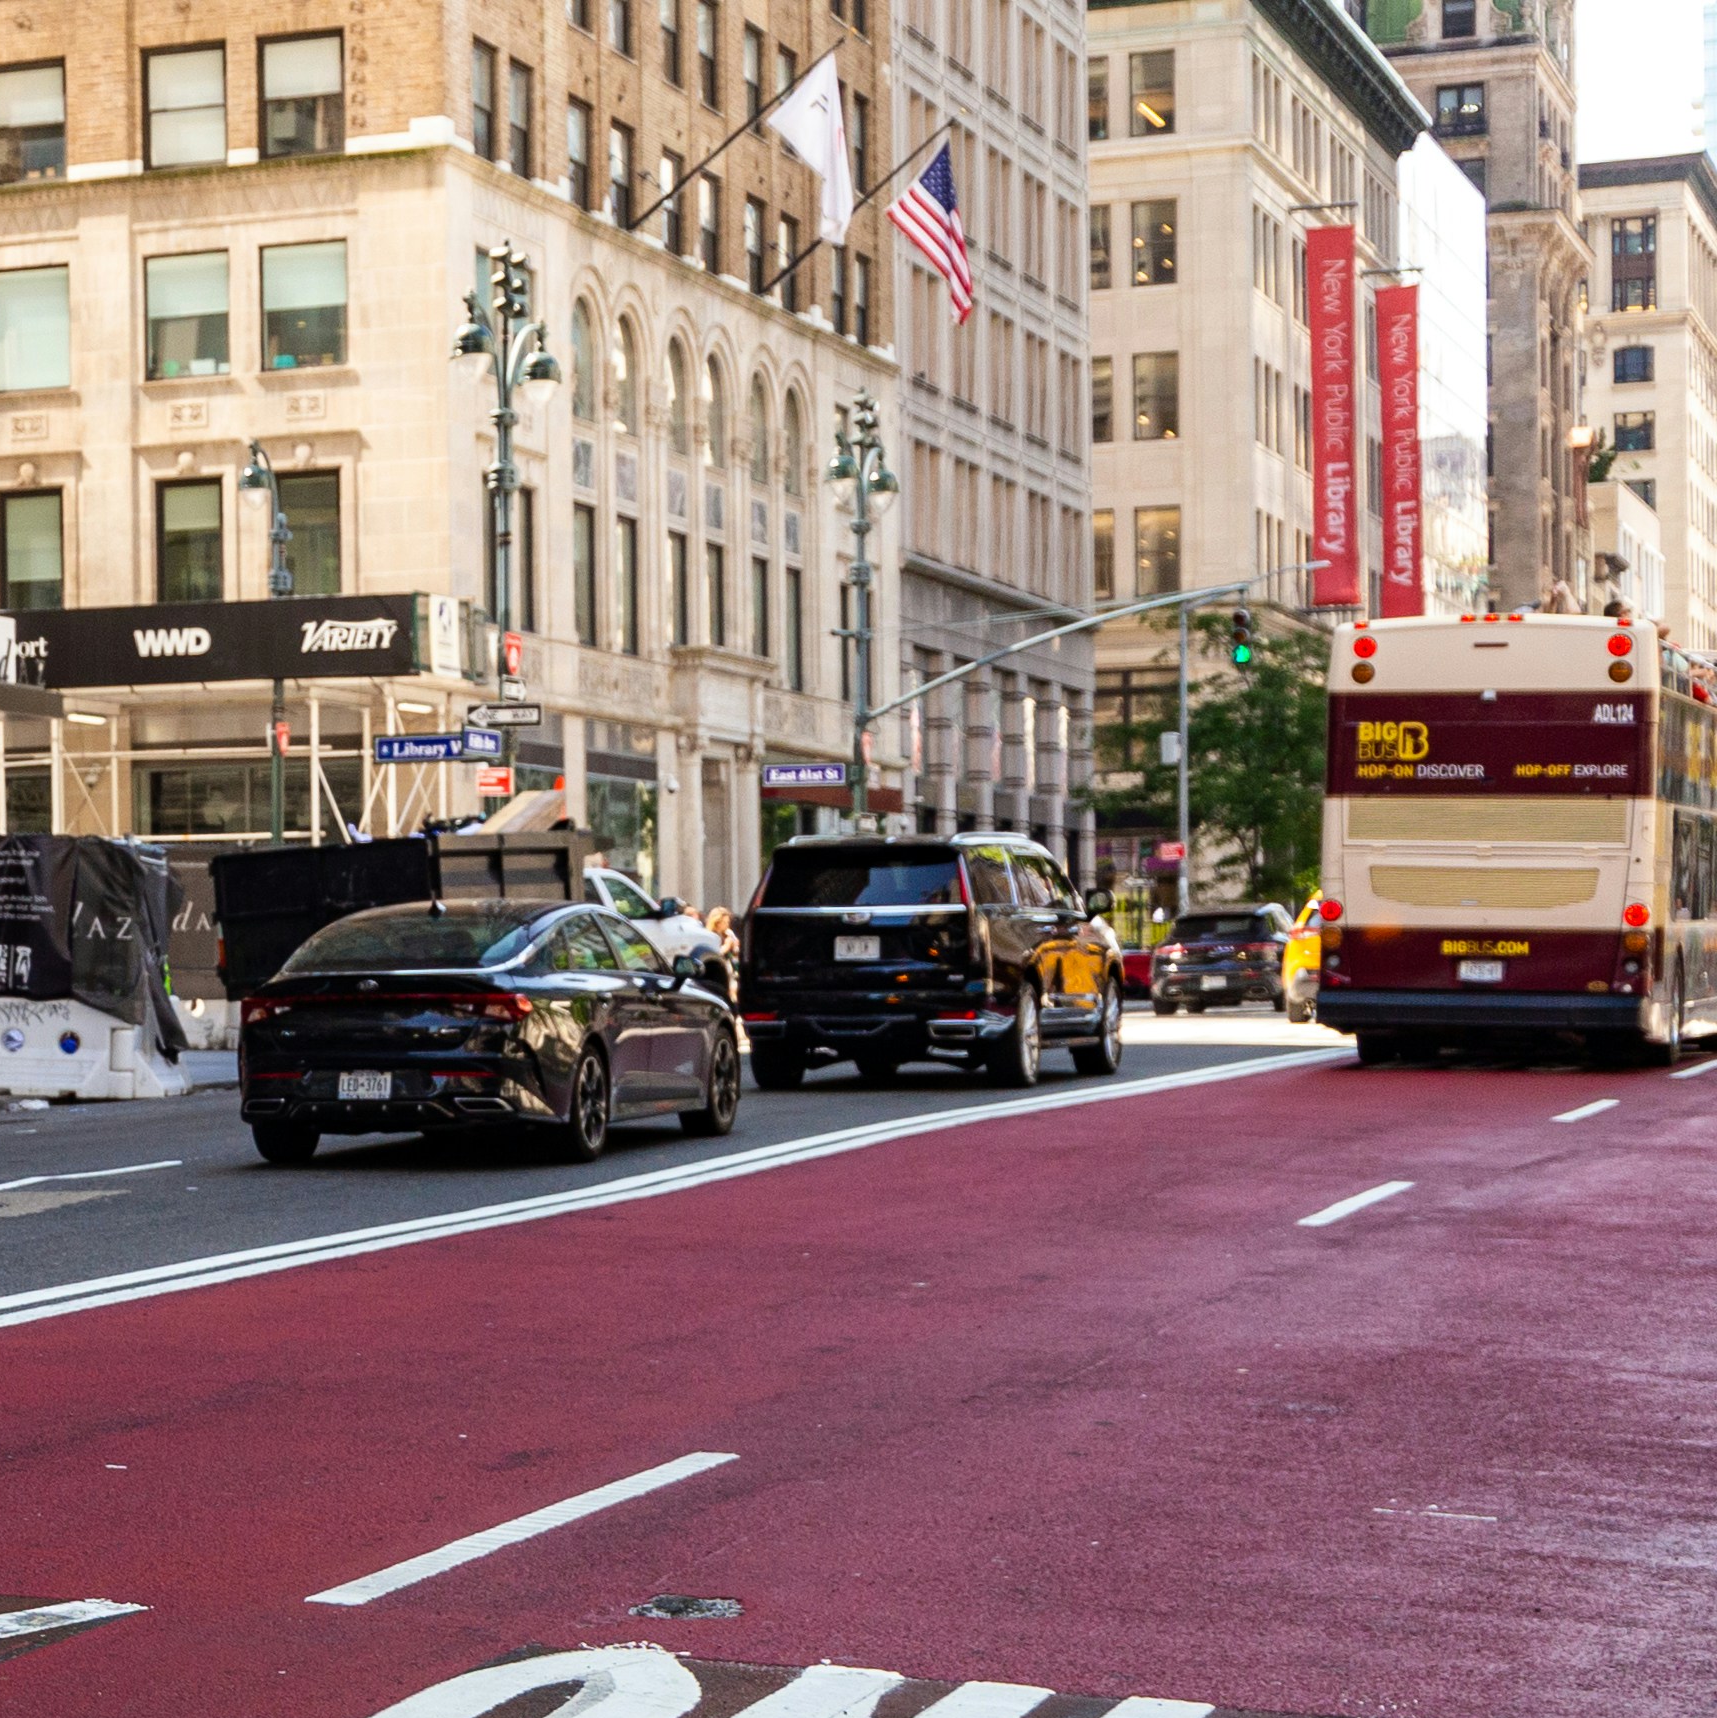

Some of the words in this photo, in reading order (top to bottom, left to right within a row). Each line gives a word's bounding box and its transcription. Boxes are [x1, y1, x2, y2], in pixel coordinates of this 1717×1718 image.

[1322, 259, 1346, 313] New
[1324, 322, 1347, 373] York
[1391, 314, 1412, 365] New
[1392, 376, 1415, 420] York
[1325, 384, 1349, 450] Public
[1393, 429, 1416, 490] Public
[1321, 461, 1350, 553] Library
[1388, 501, 1417, 586] Library
[133, 626, 213, 657] WWD
[300, 617, 399, 654] VARIETY
[1593, 704, 1635, 723] ADL124
[392, 738, 446, 758] Library
[1357, 722, 1397, 741] BIG
[1357, 741, 1397, 760] BUS
[770, 768, 796, 780] East
[798, 768, 823, 780] 41st
[825, 767, 839, 779] St
[1356, 764, 1414, 779] HOP-ON
[1417, 764, 1485, 778] DISCOVER
[1515, 764, 1572, 778] HOP-OFF
[1573, 764, 1629, 778] EXPLORE
[1441, 940, 1530, 955] BIGBUS.COM
